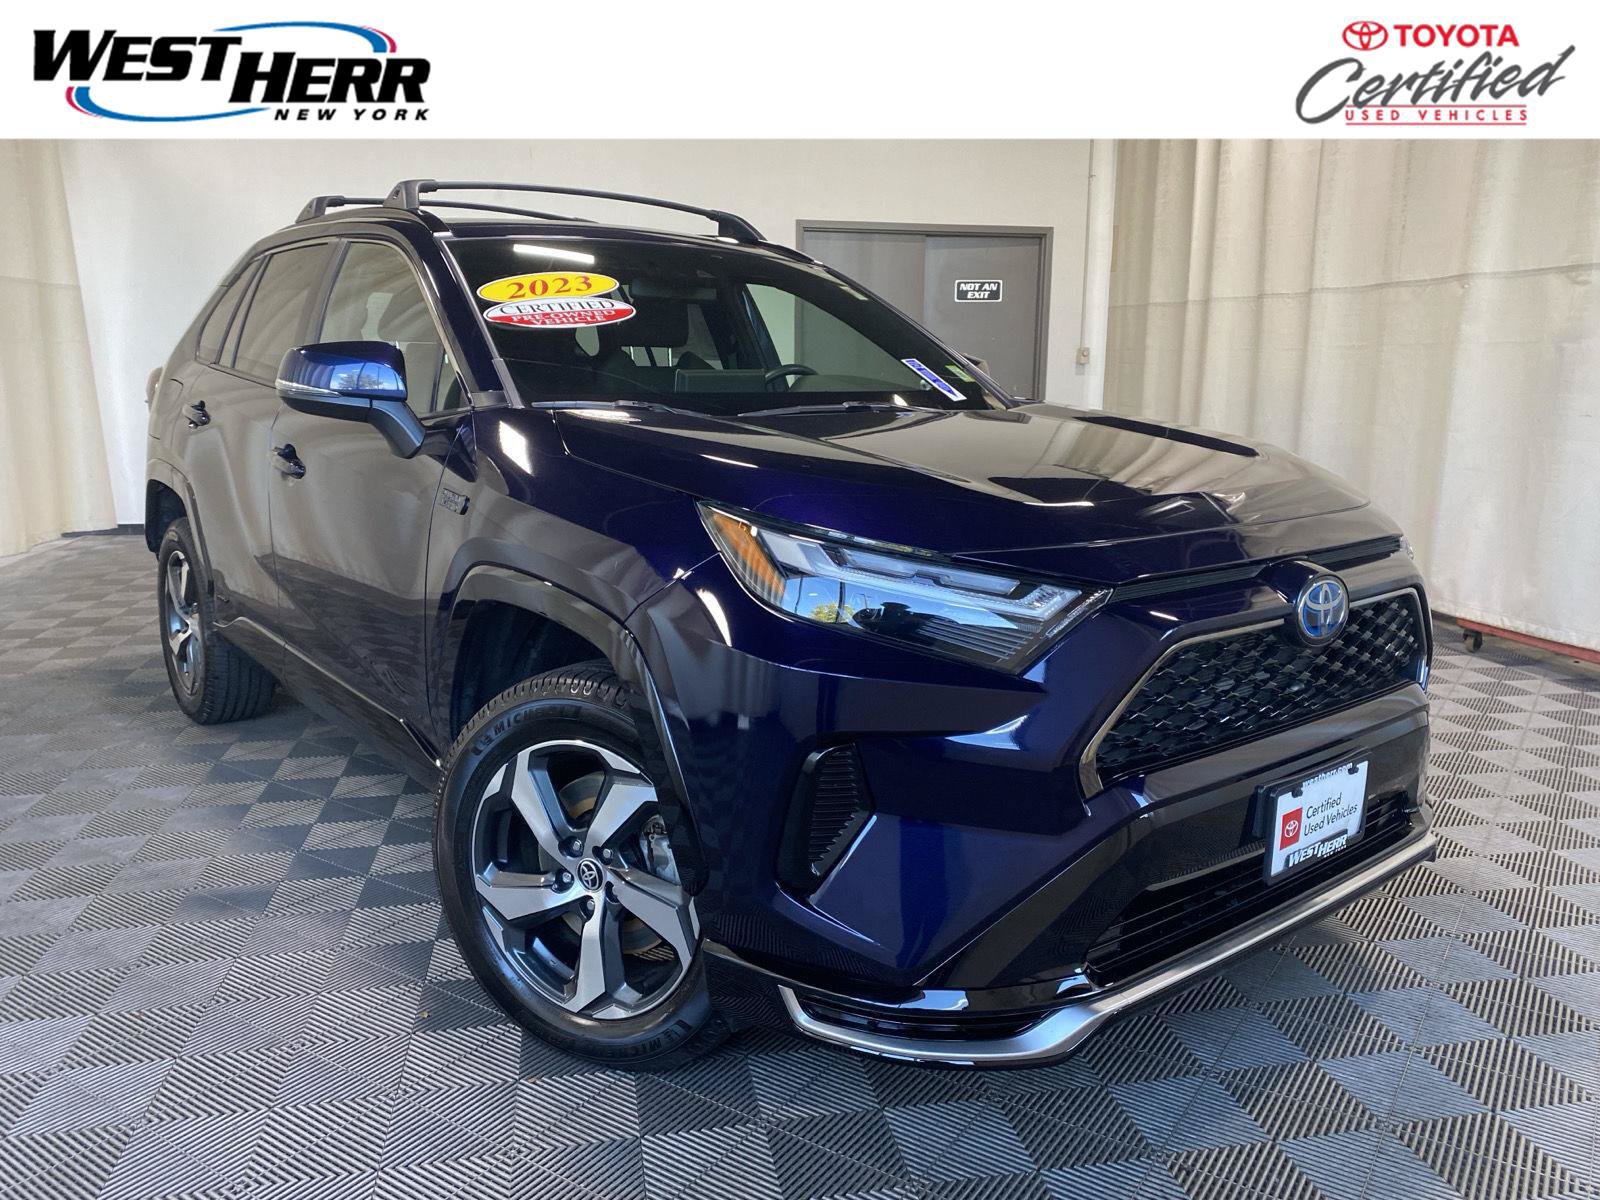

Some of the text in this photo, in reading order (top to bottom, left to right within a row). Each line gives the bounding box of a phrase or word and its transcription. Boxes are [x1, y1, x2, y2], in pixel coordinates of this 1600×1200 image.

[507, 275, 593, 300] 2023
[959, 283, 998, 291] NOT AN
[967, 291, 991, 299] EXIT
[500, 300, 615, 315] CERTIFIED
[511, 309, 616, 322] PRE-OWNED
[532, 315, 607, 326] VEHICLE
[1306, 792, 1342, 819] Certified
[1304, 804, 1358, 836] Used Vehicles
